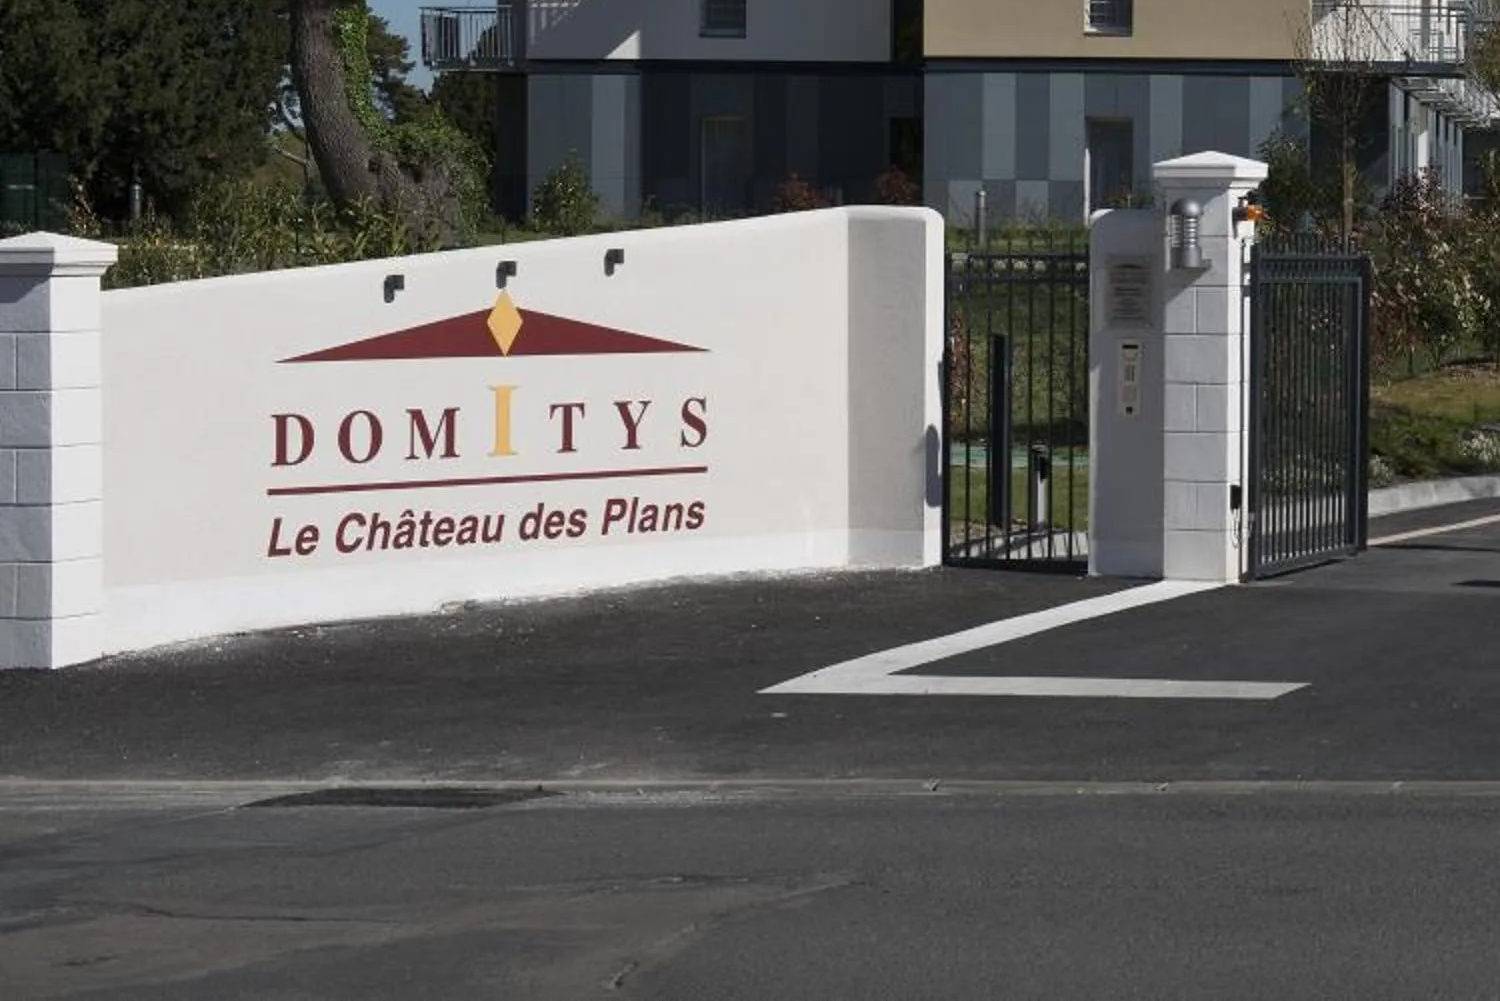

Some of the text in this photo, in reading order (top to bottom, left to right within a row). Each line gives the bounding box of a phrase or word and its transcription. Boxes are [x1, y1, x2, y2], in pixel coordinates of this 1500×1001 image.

[270, 384, 708, 466] DOMITYS
[267, 496, 706, 557] Le Château des Plans
